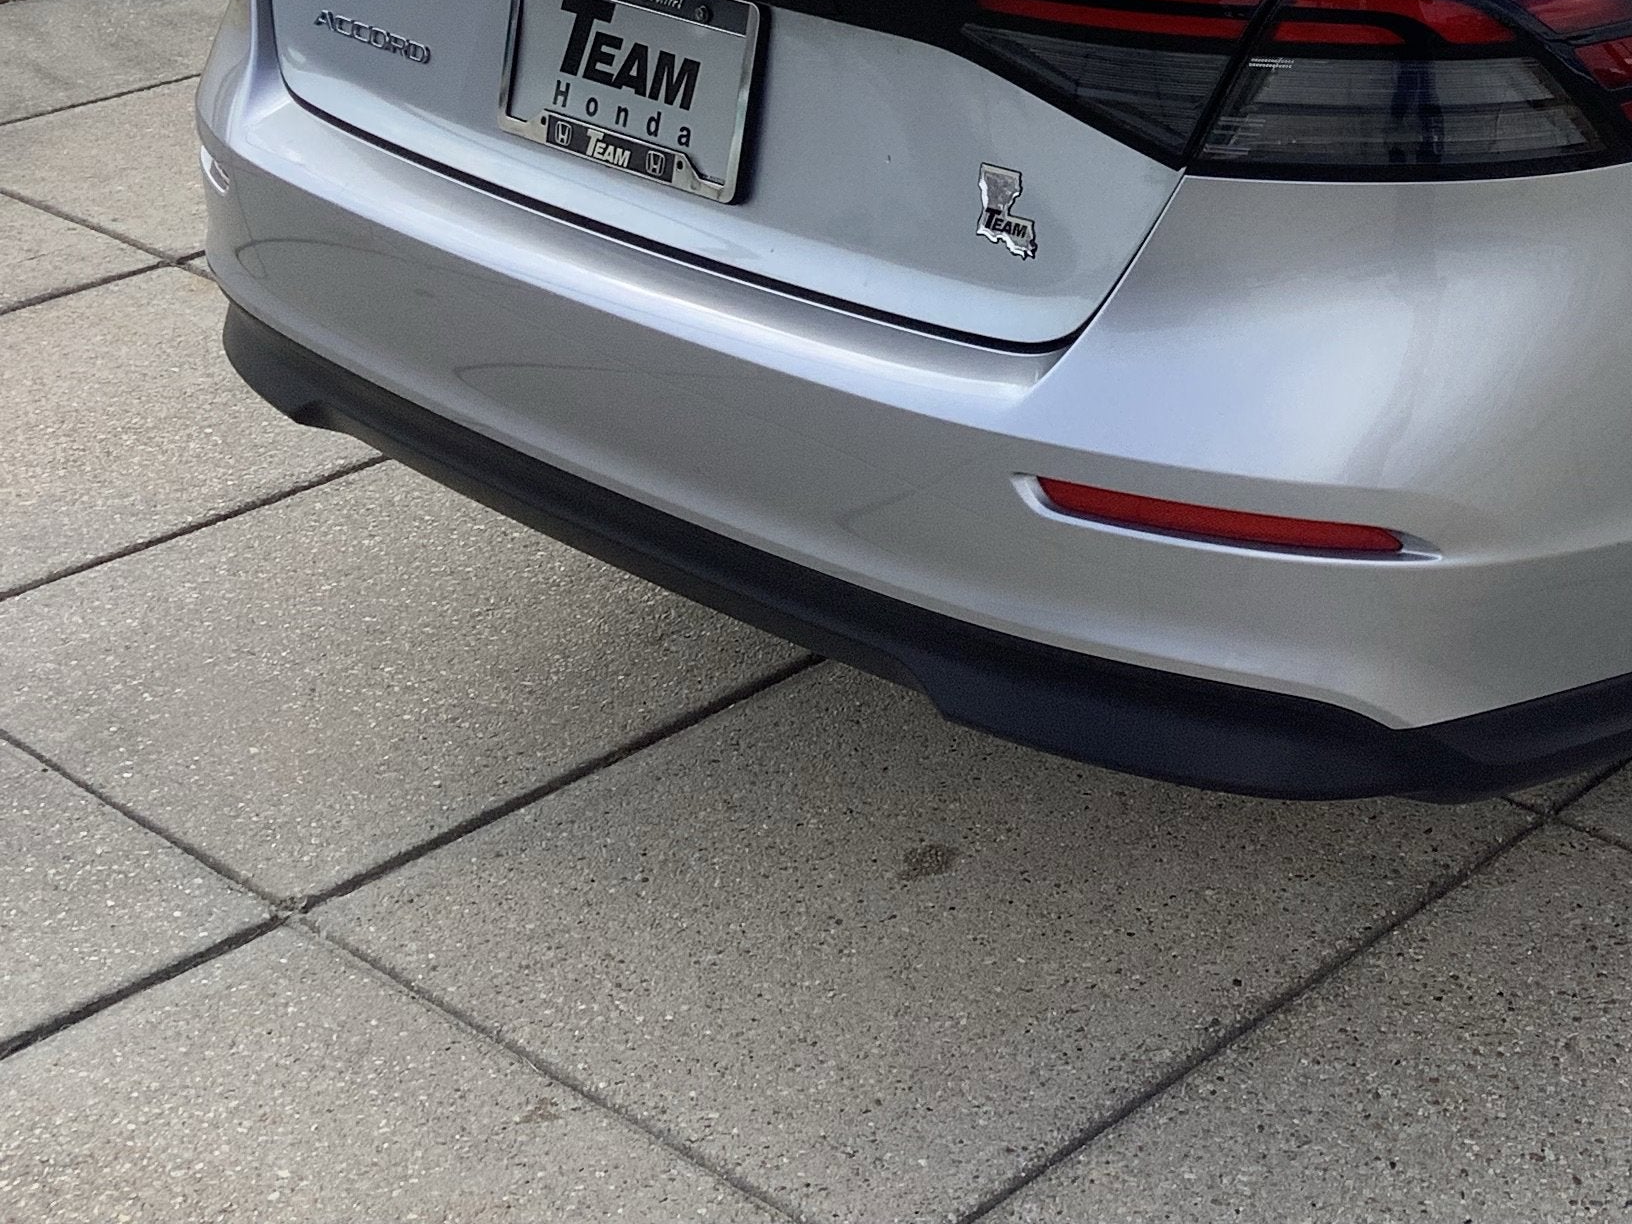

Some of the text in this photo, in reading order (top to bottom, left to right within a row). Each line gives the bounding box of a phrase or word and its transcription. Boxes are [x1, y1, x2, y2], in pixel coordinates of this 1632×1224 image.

[314, 9, 431, 64] ACCORD
[553, 79, 692, 148] Honda
[585, 129, 631, 168] TEAM
[985, 207, 1028, 238] TEAM
